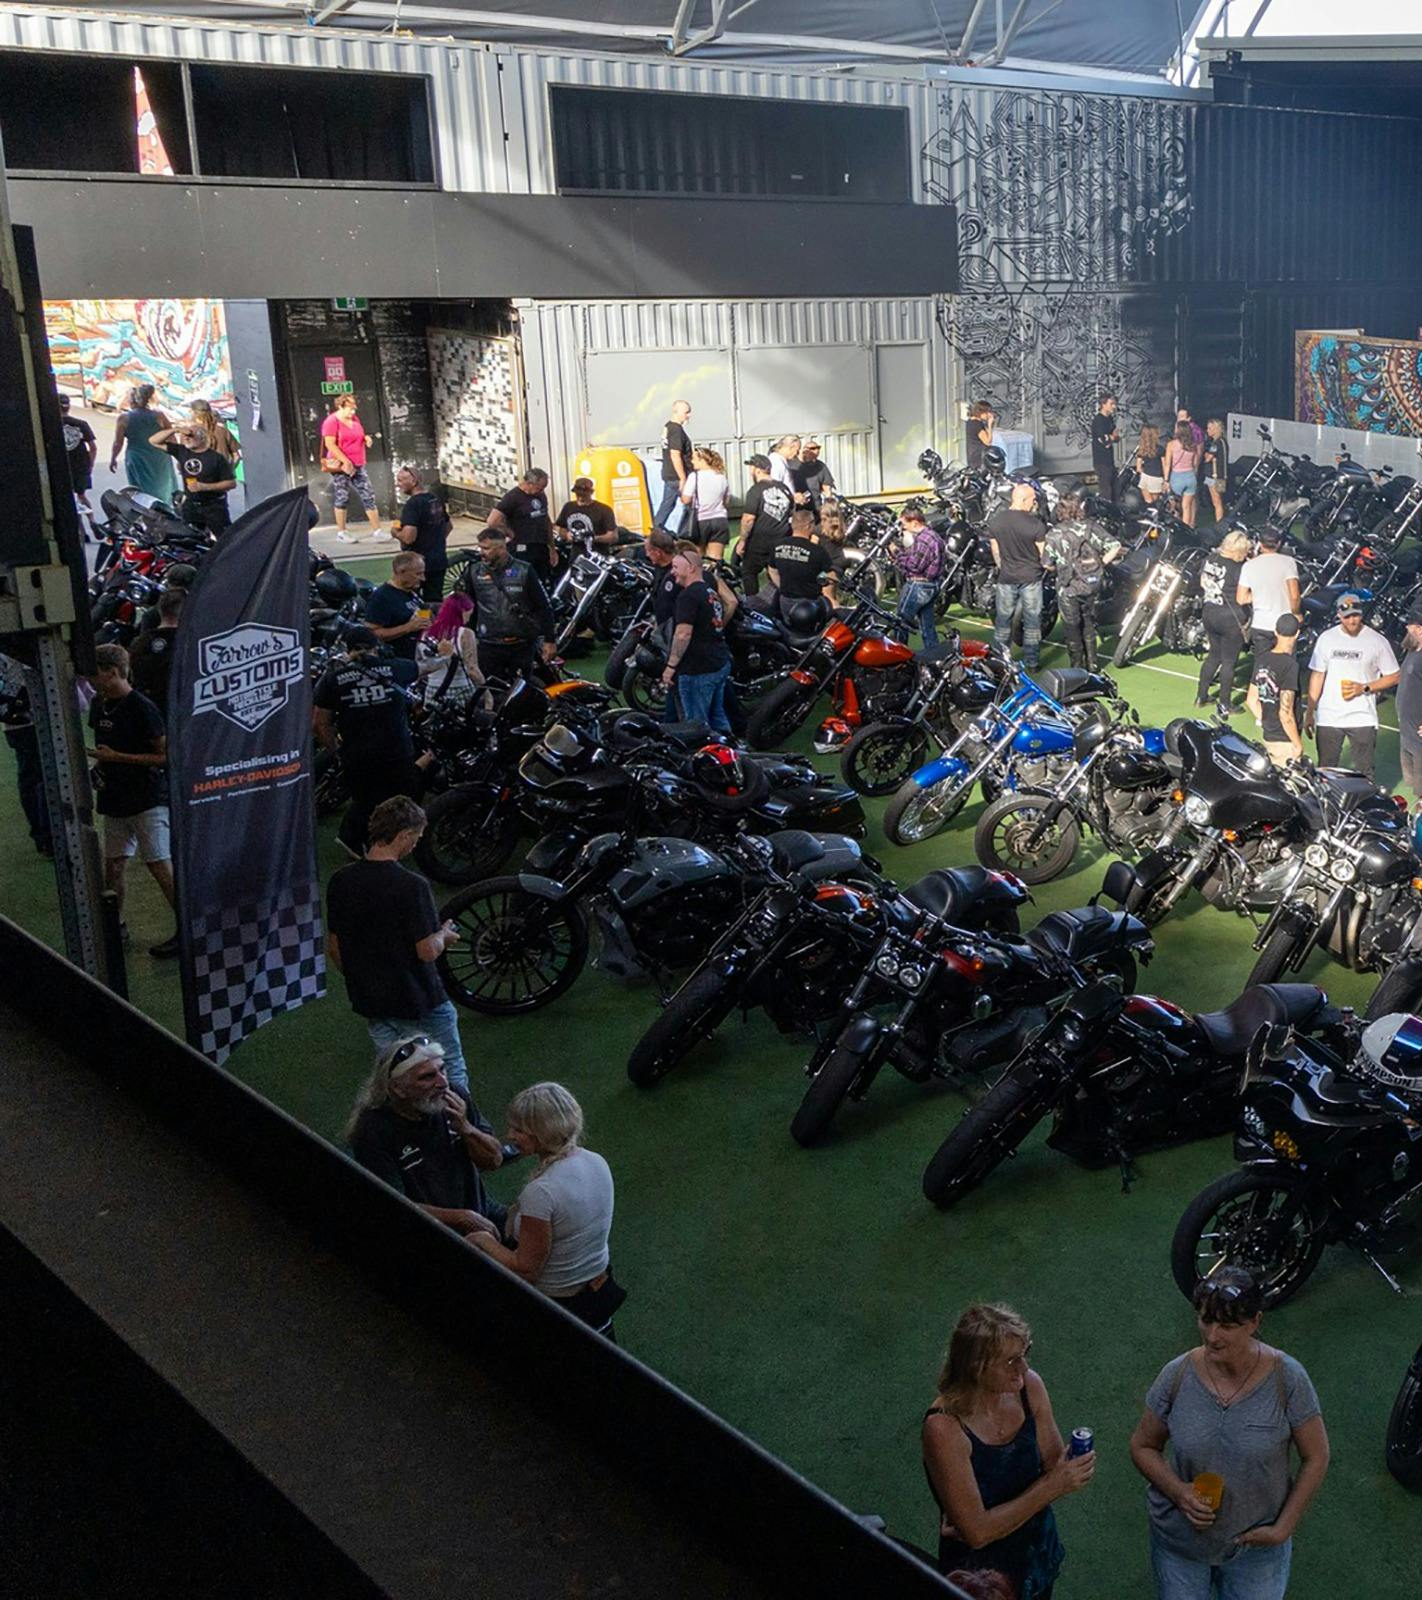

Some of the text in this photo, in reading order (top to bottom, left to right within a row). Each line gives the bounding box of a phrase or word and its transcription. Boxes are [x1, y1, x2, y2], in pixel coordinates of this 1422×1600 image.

[200, 651, 300, 700] CUSTOMS
[204, 749, 300, 777] Specialising in
